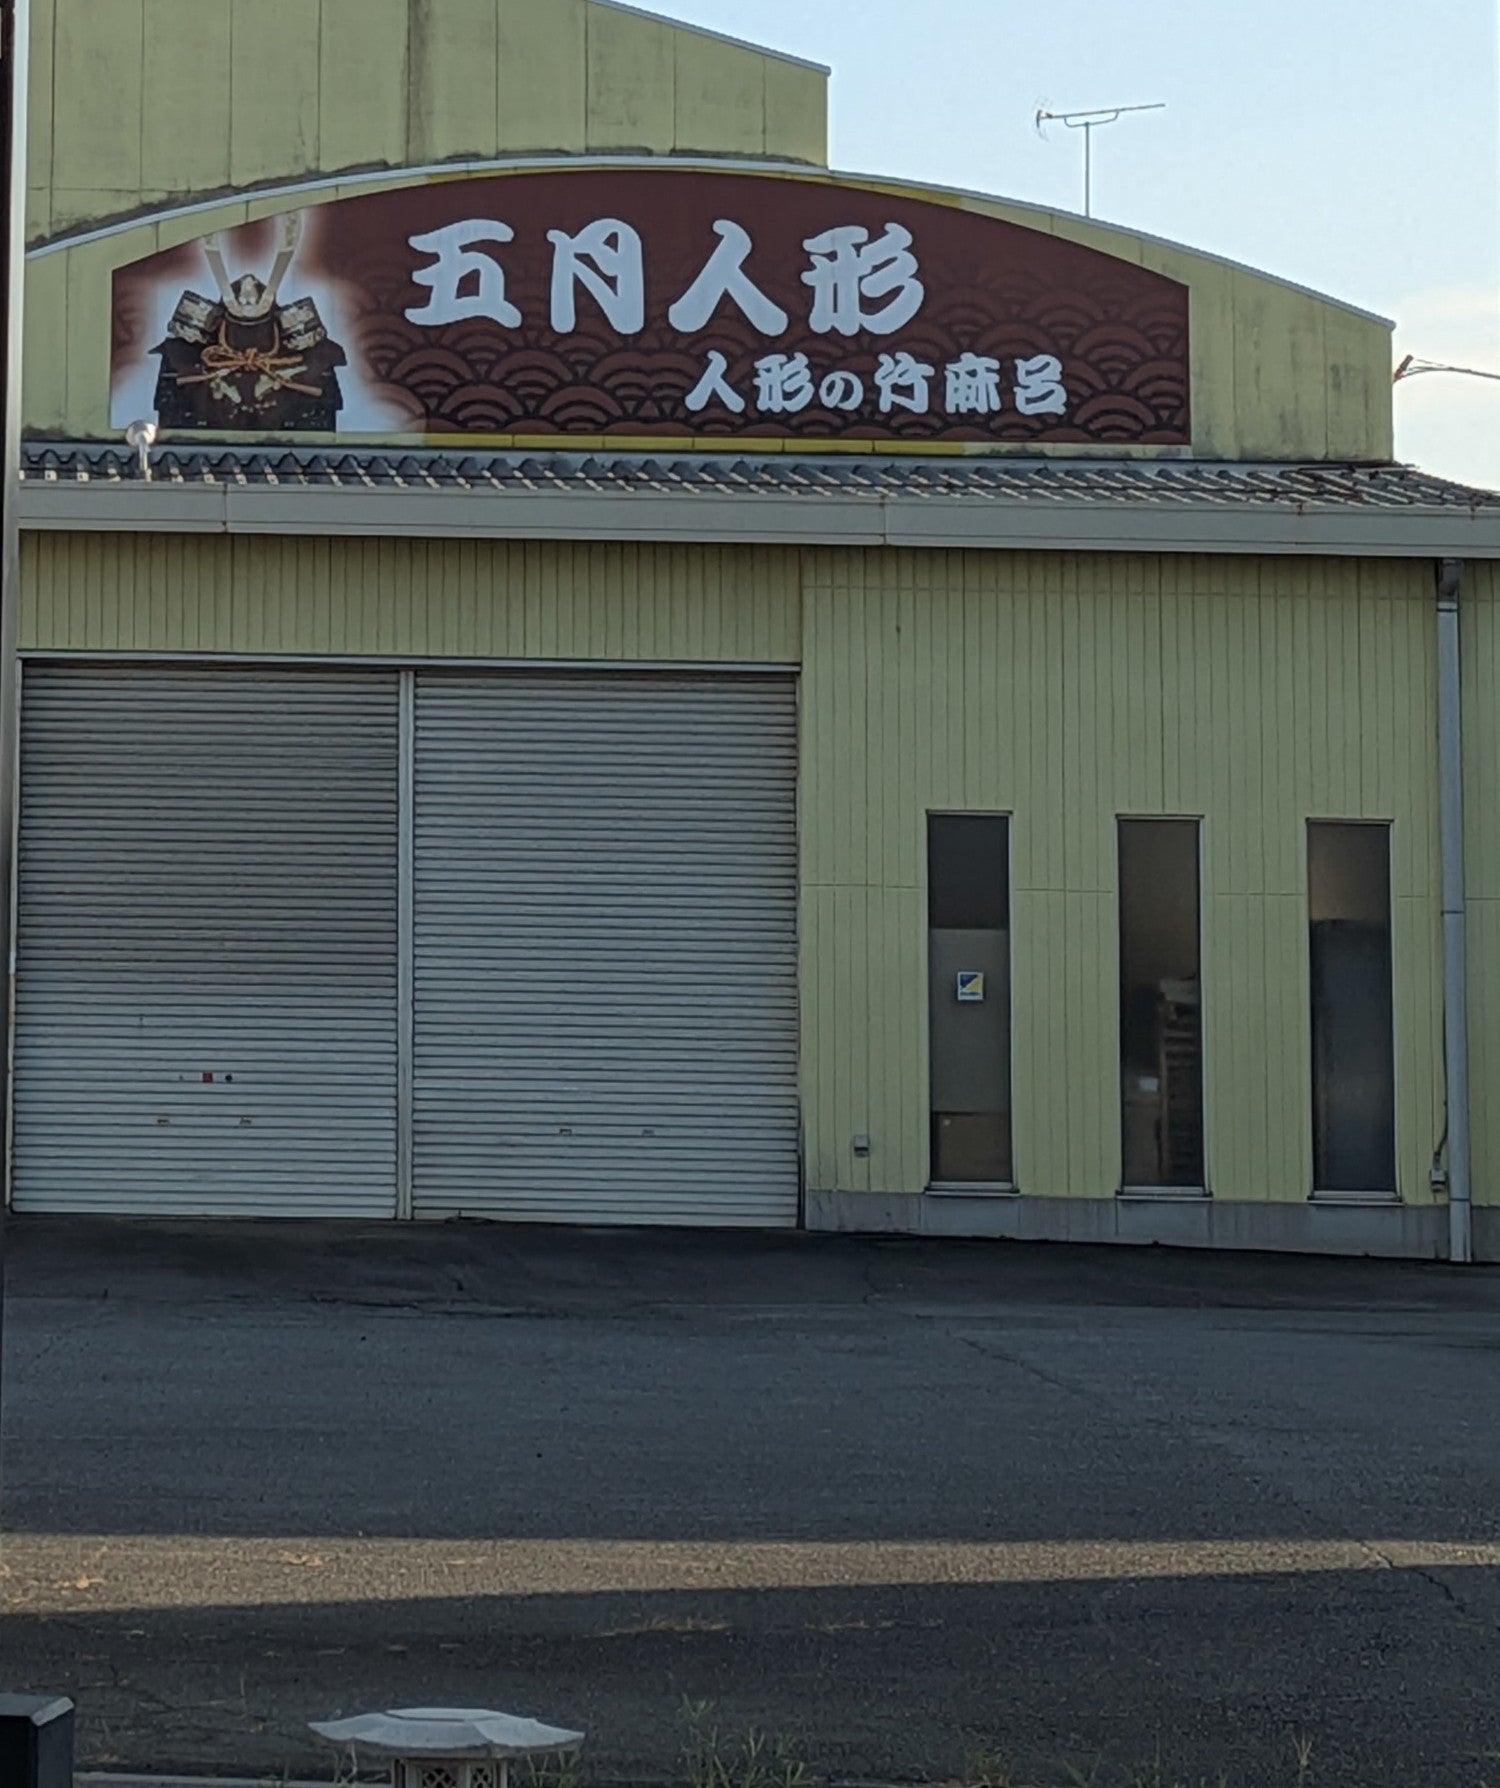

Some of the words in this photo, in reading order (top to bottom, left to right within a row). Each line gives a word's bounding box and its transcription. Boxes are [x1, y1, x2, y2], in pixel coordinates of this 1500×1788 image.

[404, 217, 925, 337] 五月人形
[684, 350, 1067, 415] 人形の竹麻呂
